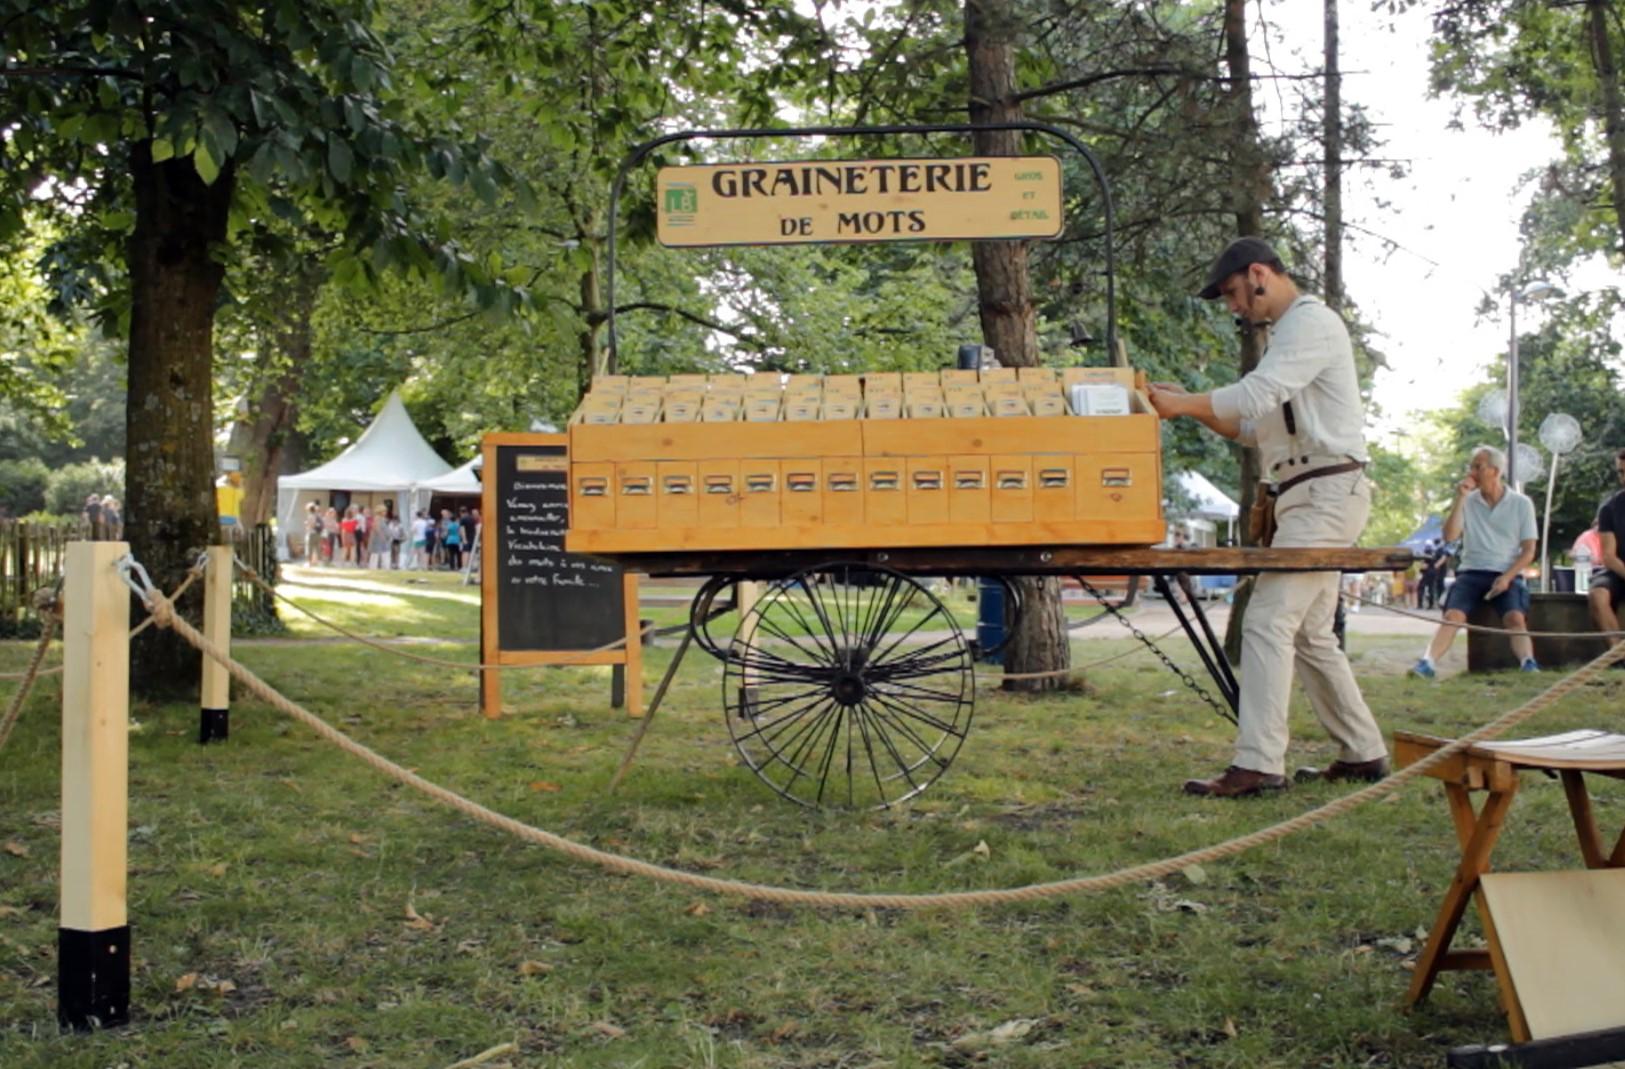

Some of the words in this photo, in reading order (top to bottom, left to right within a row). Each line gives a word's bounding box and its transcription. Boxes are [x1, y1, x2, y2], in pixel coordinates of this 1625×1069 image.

[712, 163, 992, 198] GRAINETERIE
[780, 217, 813, 236] DE
[837, 210, 926, 234] MOTS
